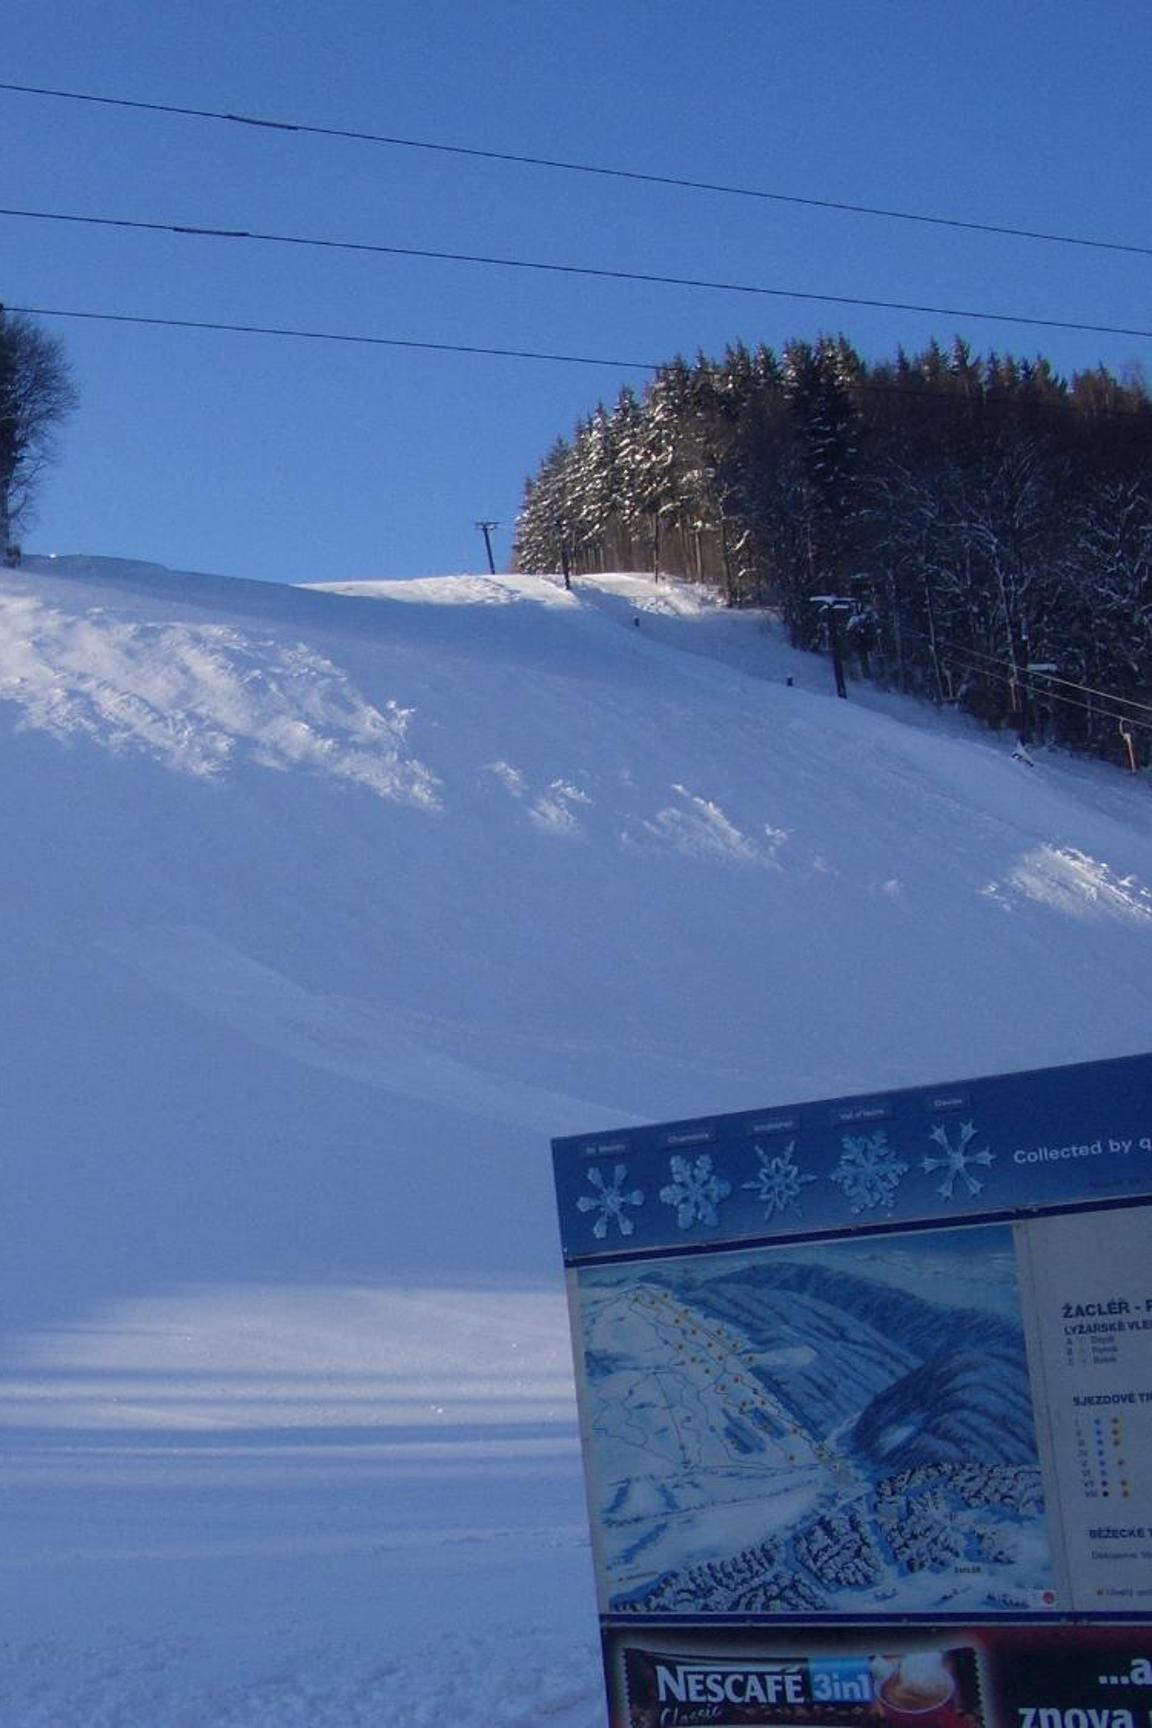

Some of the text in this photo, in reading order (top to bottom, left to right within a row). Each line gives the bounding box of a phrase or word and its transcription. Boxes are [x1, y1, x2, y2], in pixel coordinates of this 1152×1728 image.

[1014, 1140, 1103, 1164] Collected
[1108, 1138, 1133, 1155] by
[656, 1664, 805, 1704] NESCAFÉ
[812, 1674, 872, 1703] 3in1
